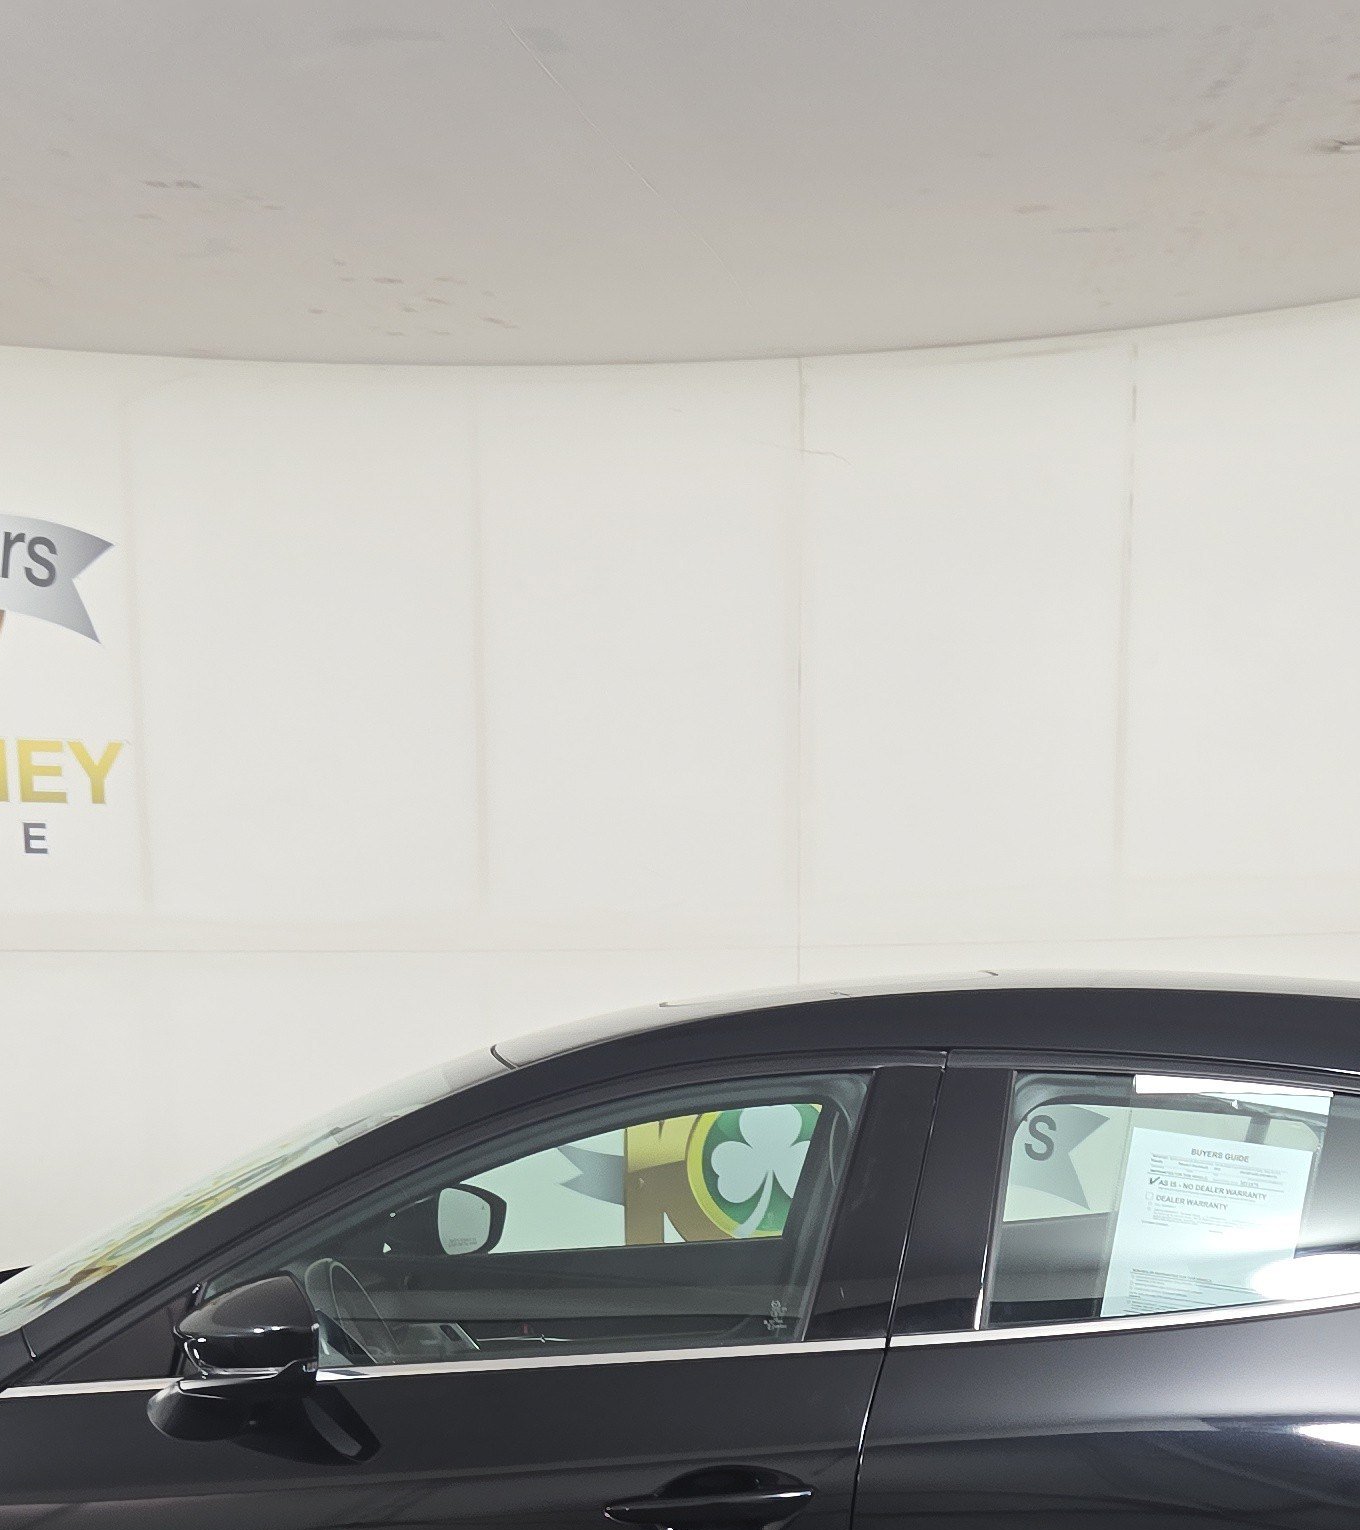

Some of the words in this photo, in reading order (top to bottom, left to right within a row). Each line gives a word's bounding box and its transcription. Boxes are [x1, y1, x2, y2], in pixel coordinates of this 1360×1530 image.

[1191, 1148, 1223, 1160] BUYERS
[1224, 1152, 1250, 1163] GUIDE
[1182, 1182, 1194, 1190] NO
[1195, 1184, 1225, 1195] DEALER
[1225, 1188, 1268, 1201] WARRANTY
[1155, 1194, 1185, 1206] DEALER
[1186, 1198, 1229, 1211] WARRANTY
